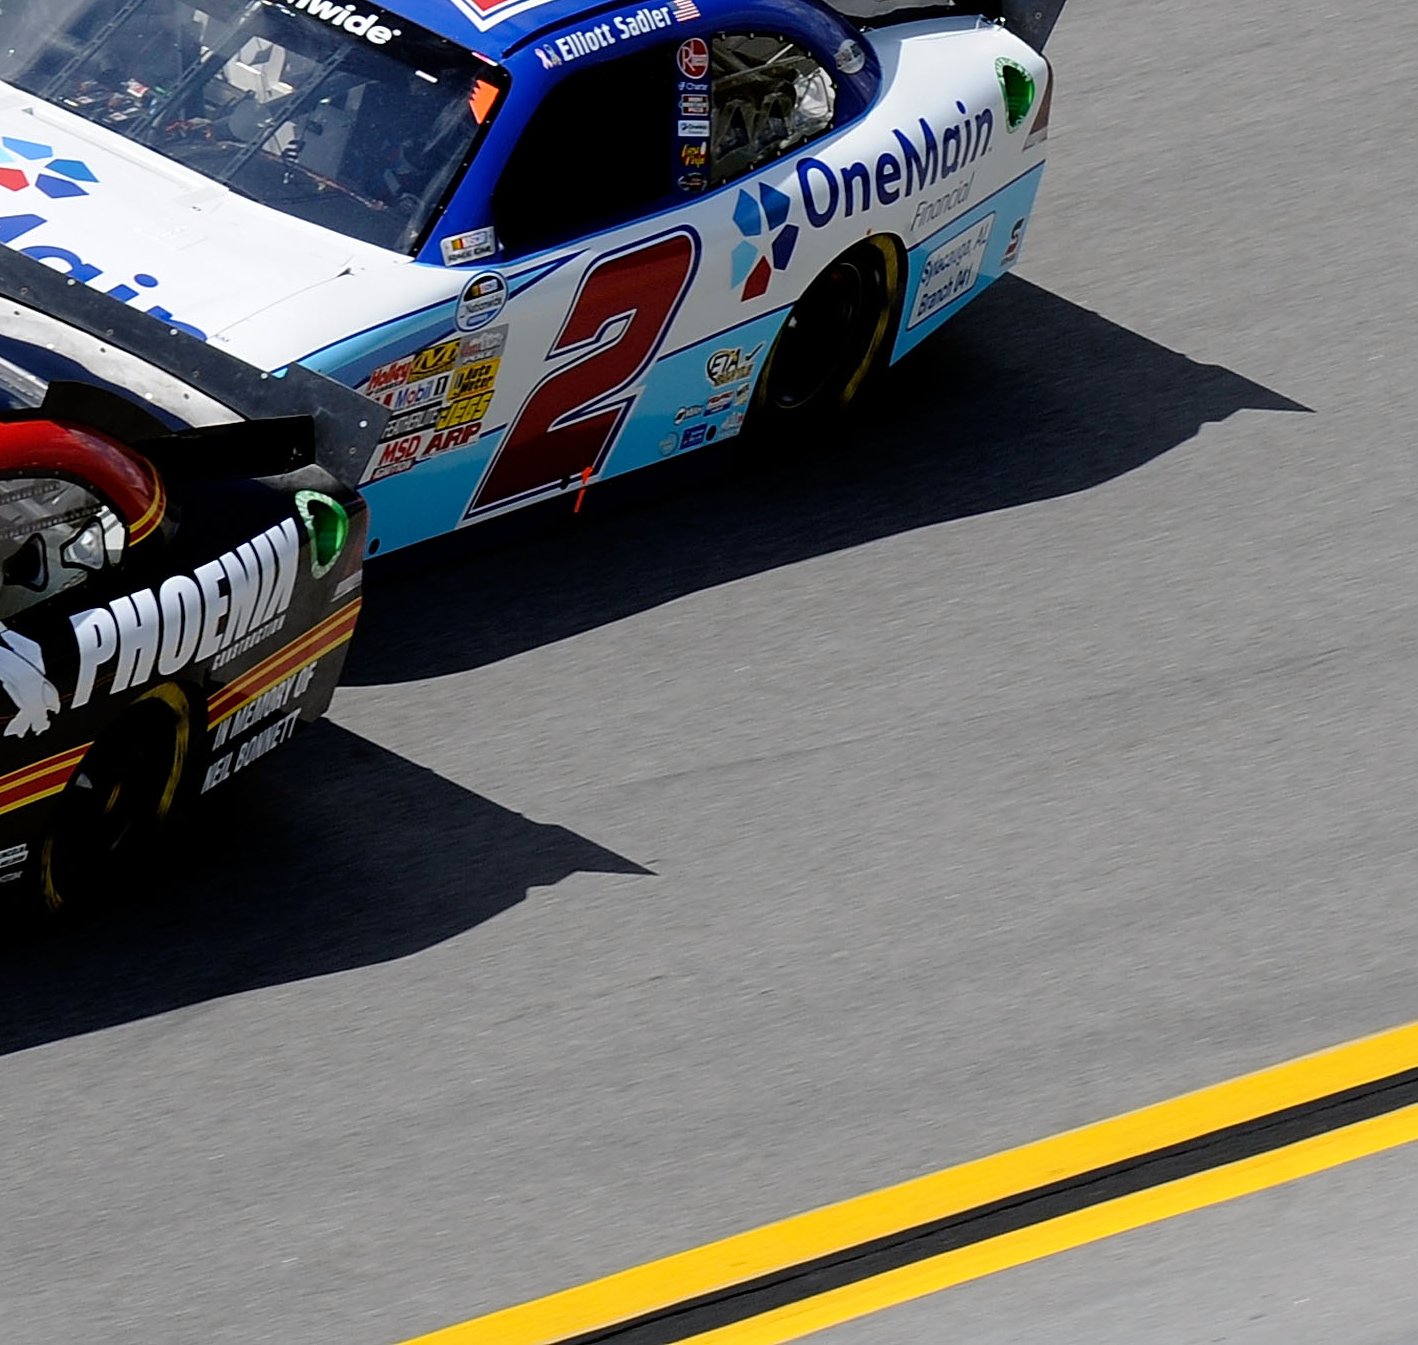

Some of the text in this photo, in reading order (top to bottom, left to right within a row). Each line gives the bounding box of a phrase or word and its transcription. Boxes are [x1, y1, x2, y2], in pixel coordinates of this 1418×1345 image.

[555, 6, 673, 62] Elliott Sadler
[797, 100, 993, 228] OneMain
[910, 171, 976, 232] Financial
[917, 278, 953, 318] Branch
[368, 361, 411, 391] Holley
[395, 374, 450, 408] Mobil 1
[458, 225, 701, 528] 2
[436, 390, 495, 431] JEGS
[378, 434, 422, 467] MSD
[422, 421, 483, 456] ARP
[67, 517, 301, 711] PHOENIX
[229, 672, 299, 740] MEMORY
[292, 660, 319, 699] OF
